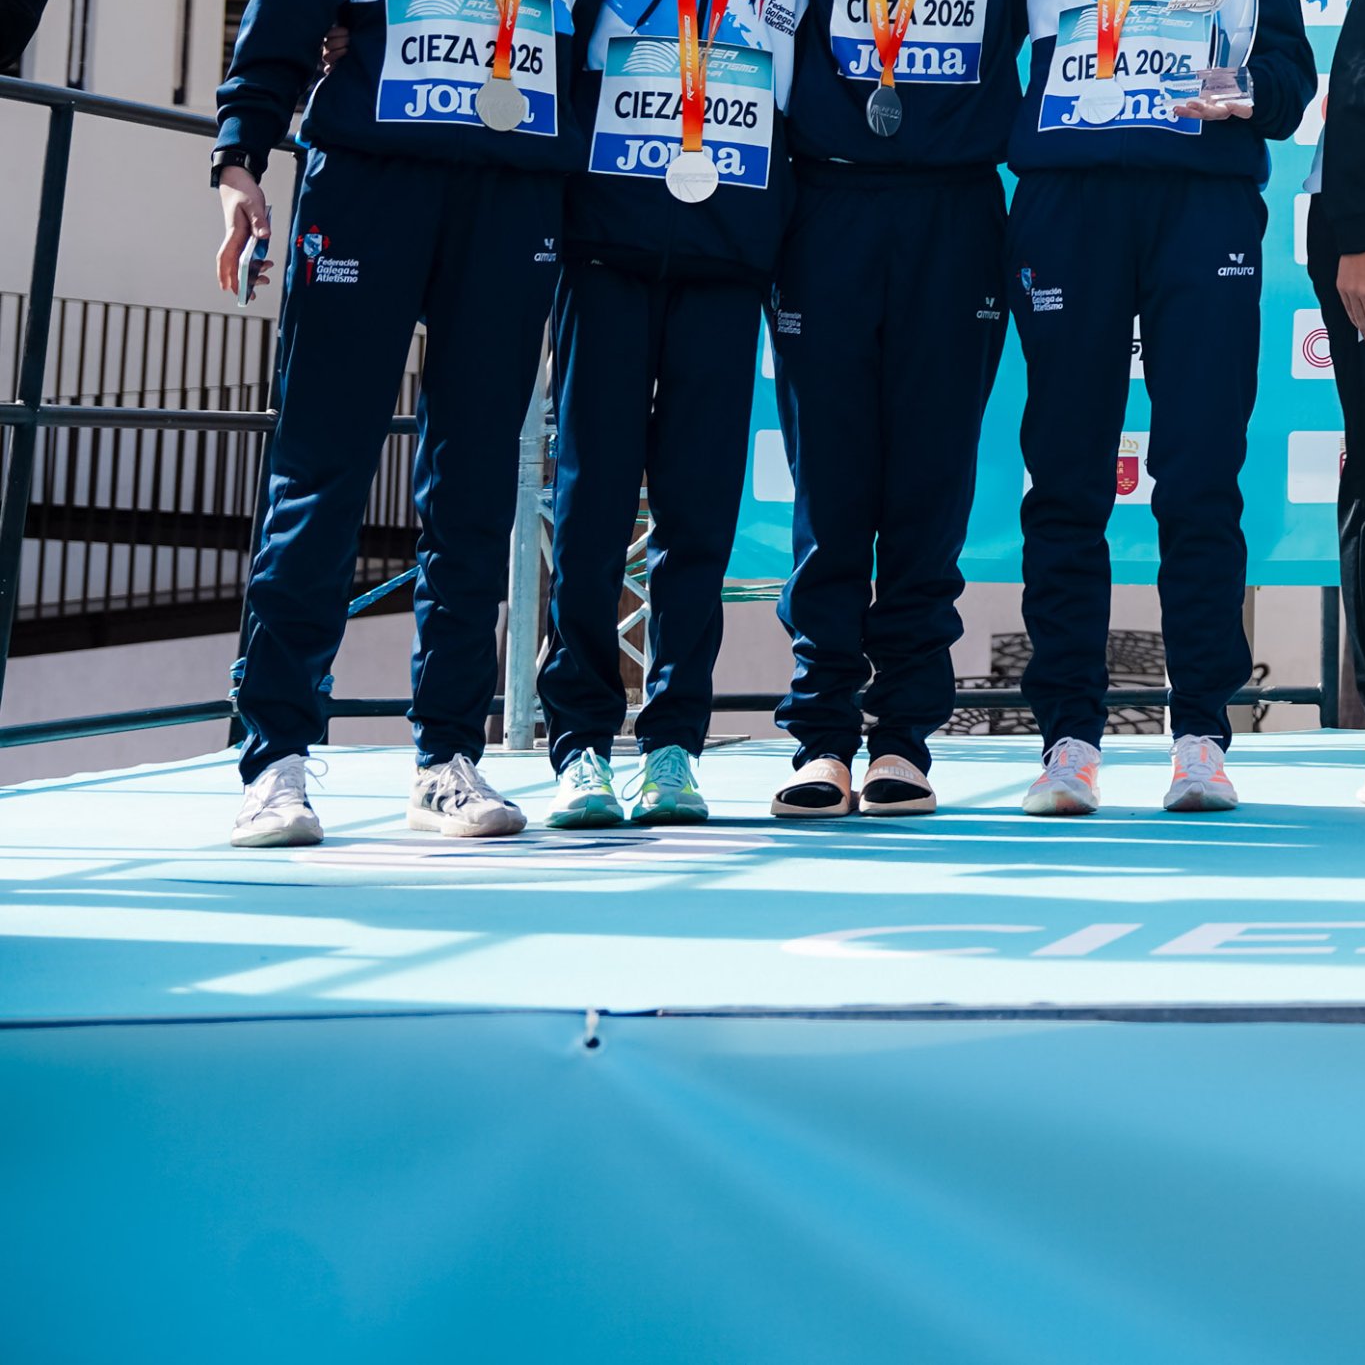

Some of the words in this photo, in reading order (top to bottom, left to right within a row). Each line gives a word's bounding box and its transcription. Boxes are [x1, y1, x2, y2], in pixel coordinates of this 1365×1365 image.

[401, 33, 479, 66] CIEZA
[614, 90, 686, 122] CIEZA
[703, 96, 758, 128] 2026
[1217, 265, 1255, 277] amura
